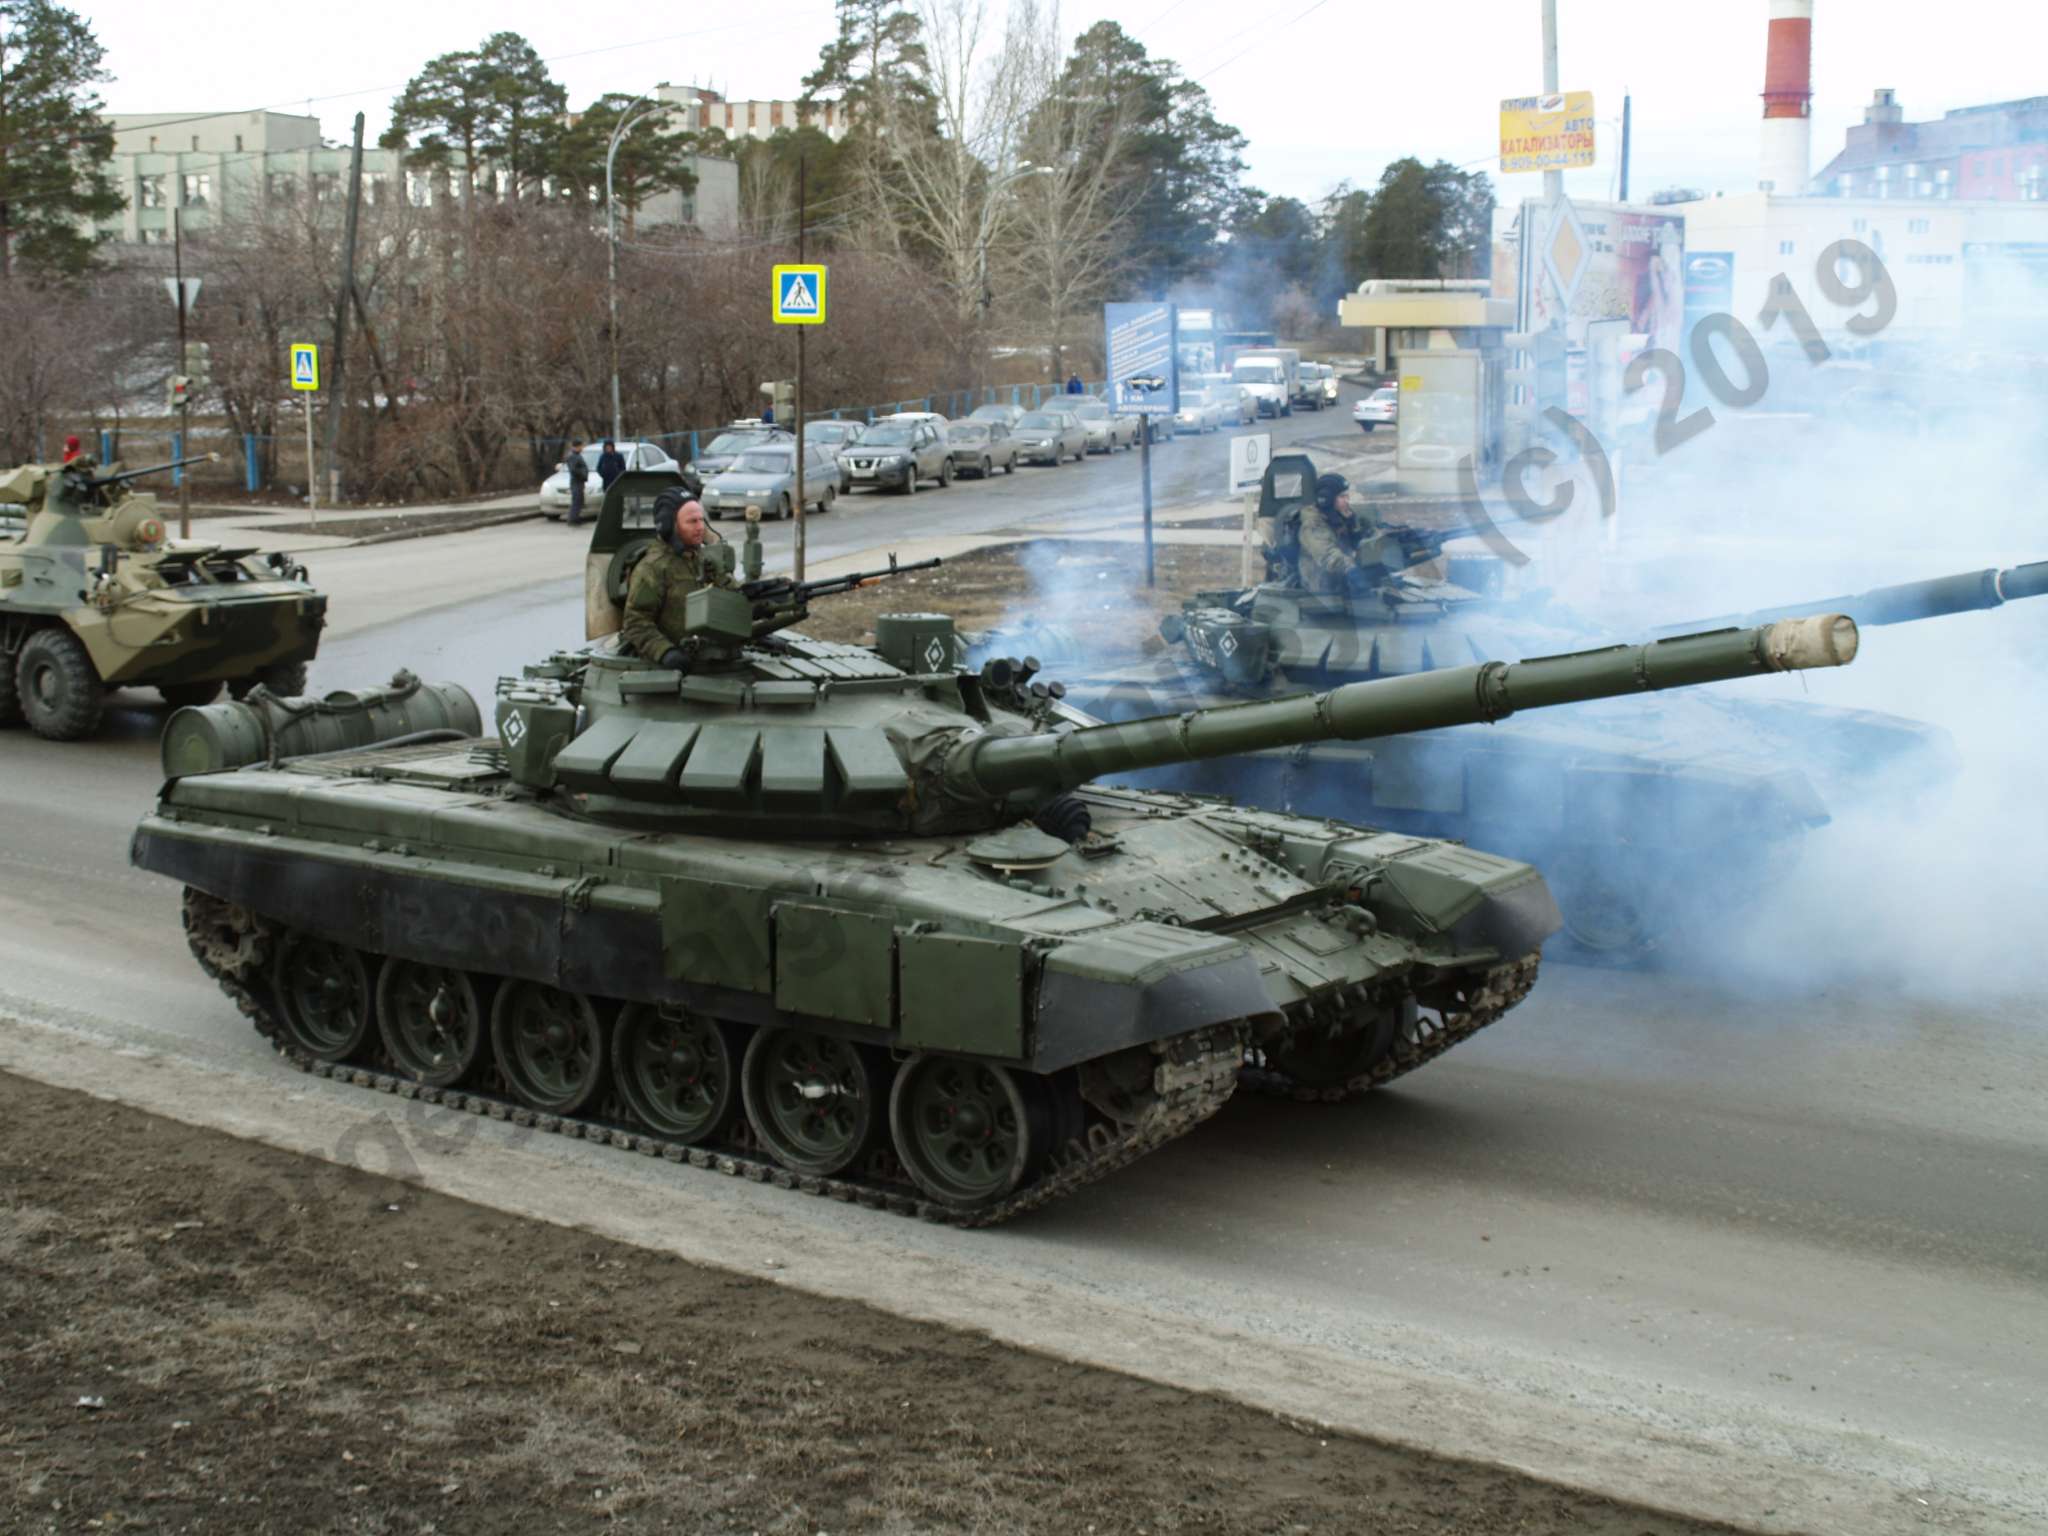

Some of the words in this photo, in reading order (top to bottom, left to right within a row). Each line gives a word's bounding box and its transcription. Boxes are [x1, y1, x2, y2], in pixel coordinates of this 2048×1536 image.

[1500, 97, 1538, 112] КУПИМ
[1564, 118, 1595, 132] АВТО
[1500, 133, 1595, 154] КАТАЛИЗАТОРЫ
